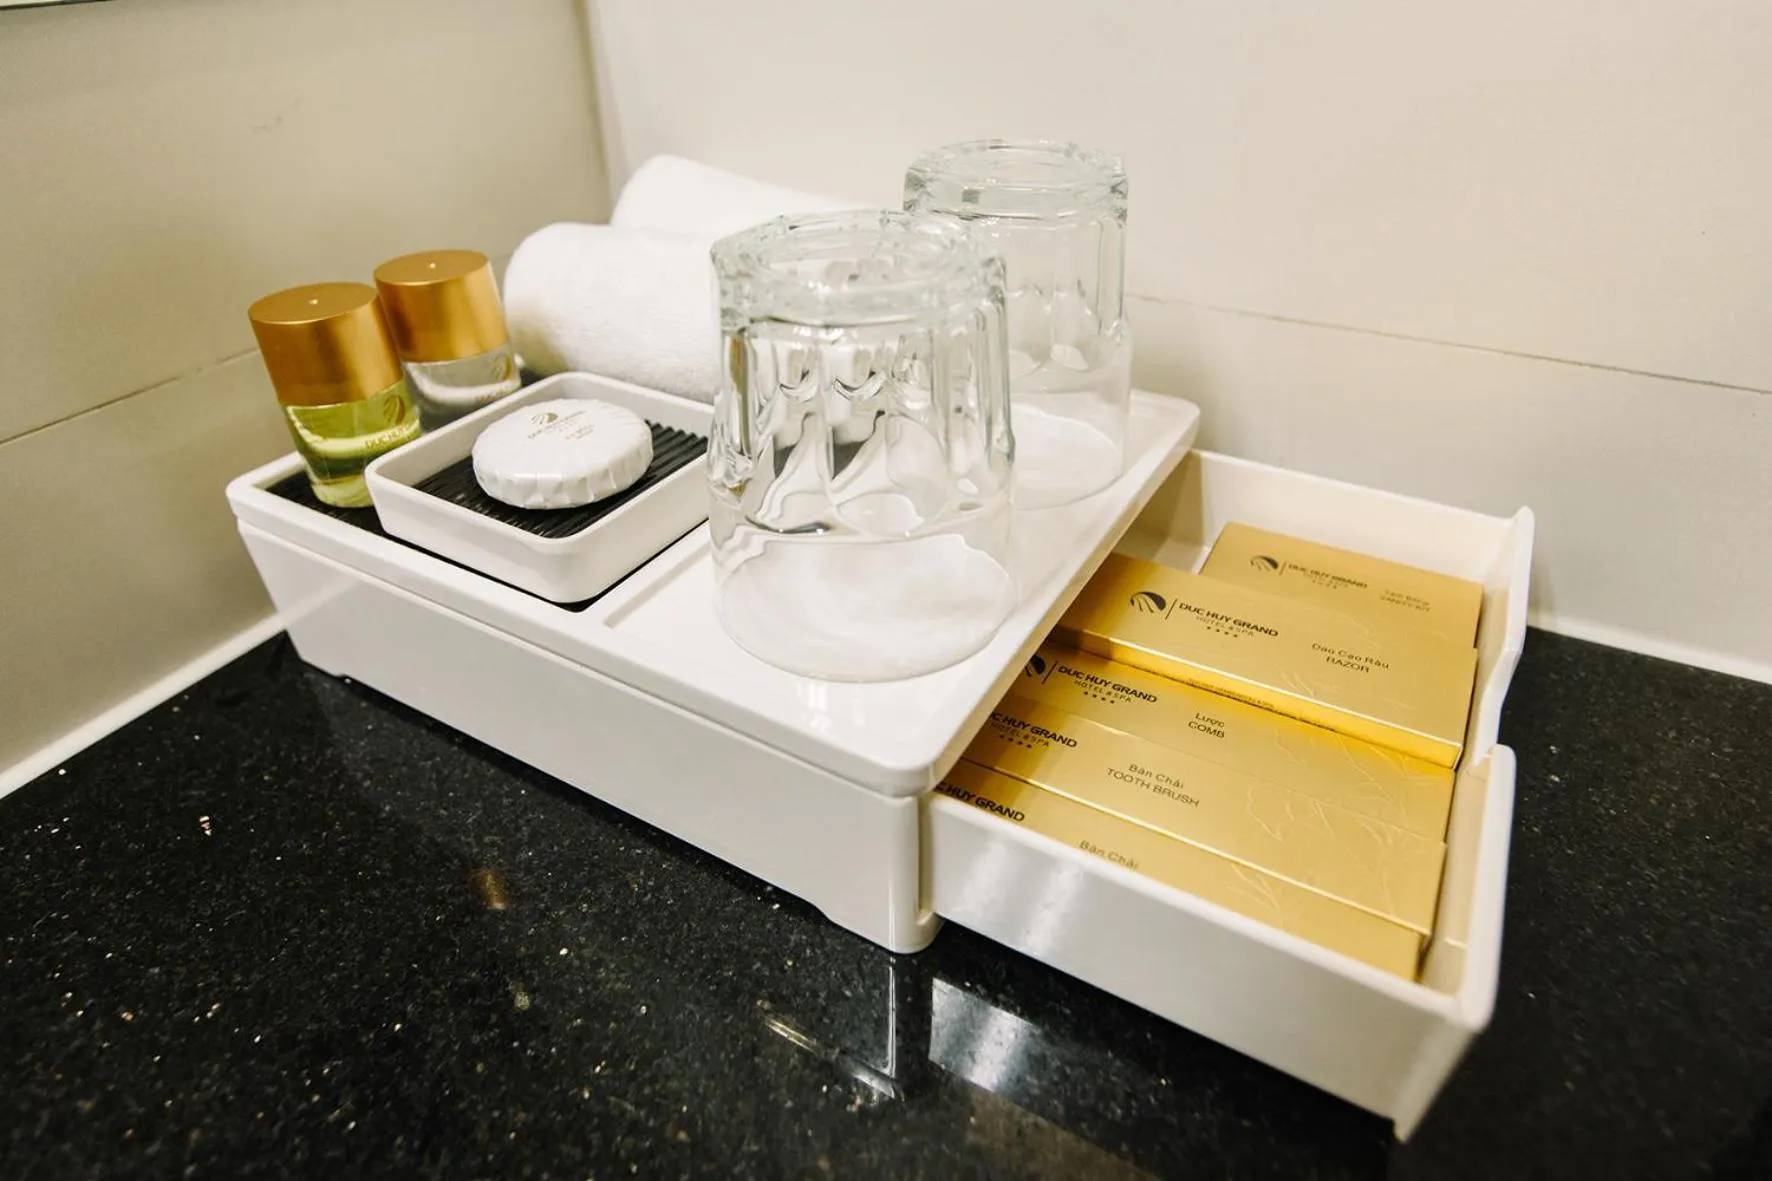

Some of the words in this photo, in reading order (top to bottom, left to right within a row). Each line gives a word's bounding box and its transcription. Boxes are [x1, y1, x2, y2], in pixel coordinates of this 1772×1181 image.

[1178, 602, 1206, 616] DUC
[1206, 610, 1232, 623] HUY
[1232, 618, 1280, 638] GRAND
[1311, 642, 1336, 655] Dao
[1337, 649, 1362, 662] Cao
[1325, 655, 1371, 674] RAZOR
[1057, 665, 1085, 681] DUC
[1085, 673, 1112, 688] HUY
[1111, 683, 1158, 703] GRAND
[1073, 679, 1105, 695] HOTEL
[1002, 715, 1031, 730] HUY
[1030, 725, 1078, 748] GRAND
[1188, 720, 1225, 739] COMB
[946, 784, 975, 802] HUY
[975, 796, 1026, 822] GRAND
[1106, 767, 1151, 790] TOOTH
[1152, 783, 1200, 808] BRUSH
